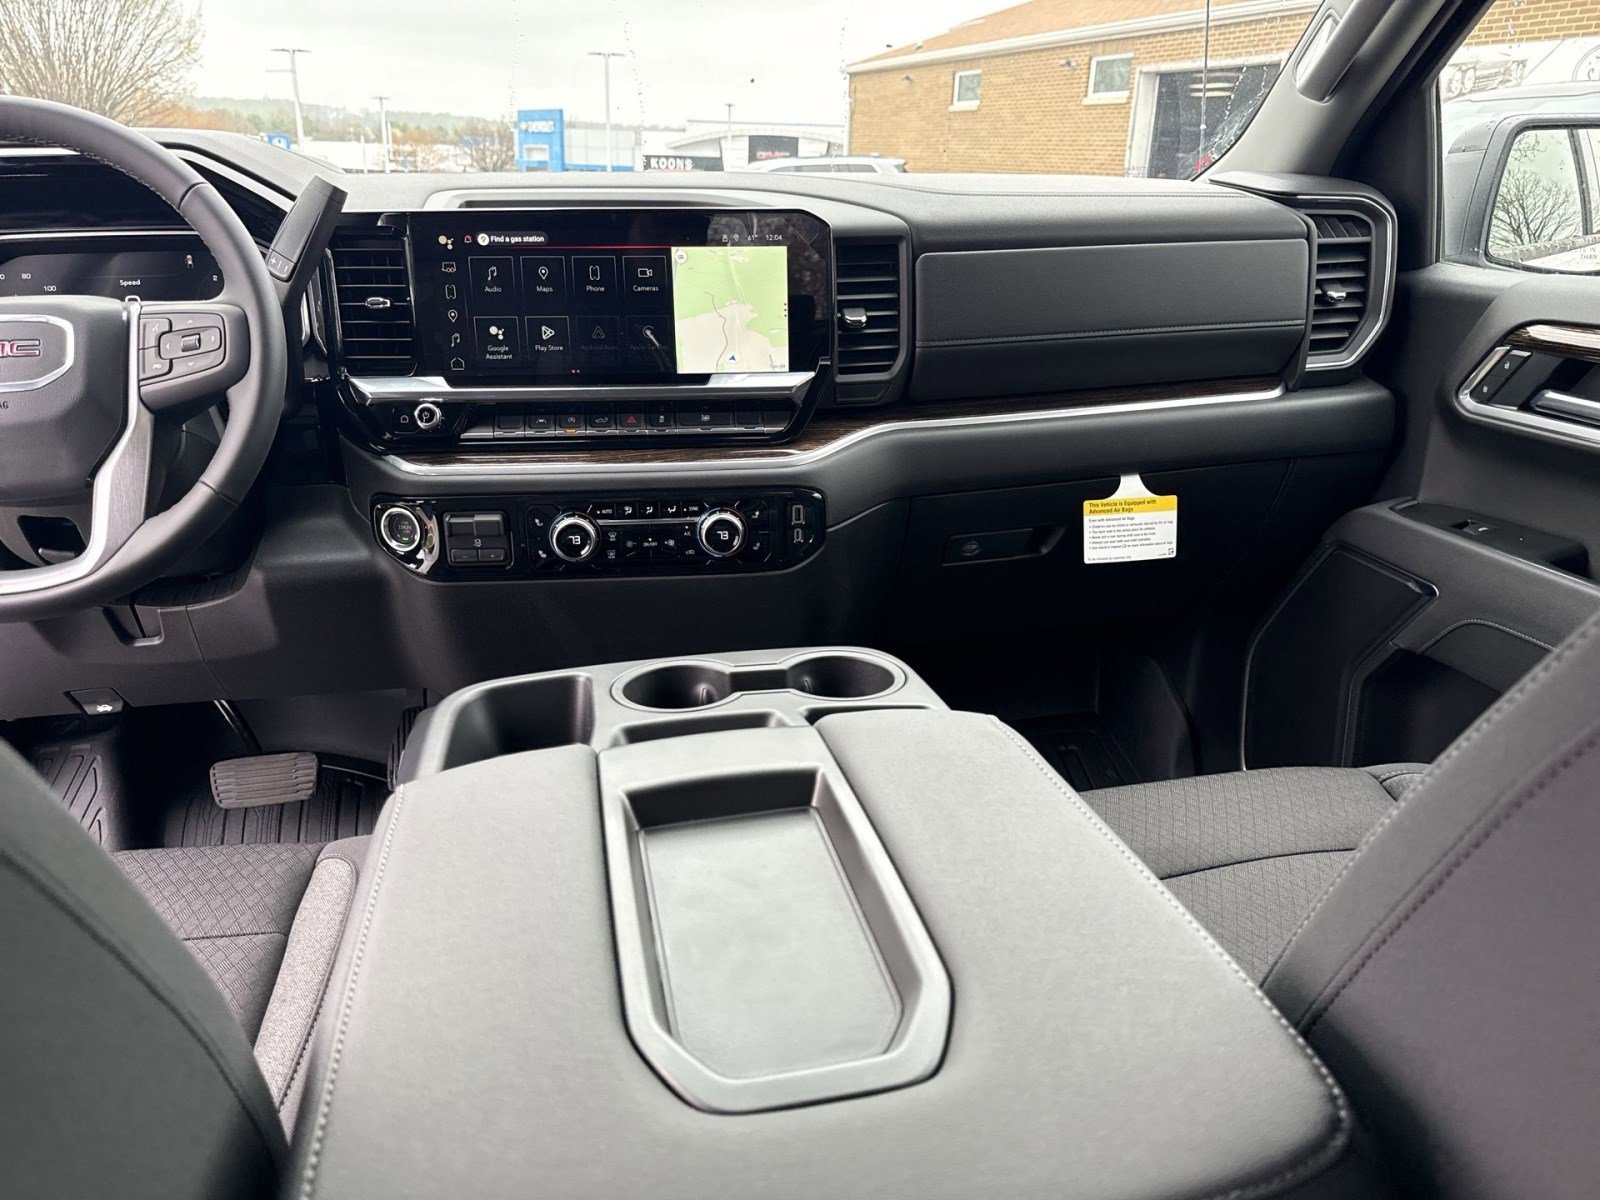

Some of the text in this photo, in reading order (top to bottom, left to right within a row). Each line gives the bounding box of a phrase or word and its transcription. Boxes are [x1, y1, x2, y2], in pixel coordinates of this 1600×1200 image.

[650, 157, 693, 170] KOONS
[490, 235, 504, 243] Find
[119, 278, 141, 287] Speed
[536, 286, 553, 294] Maps
[632, 284, 659, 292] Cameras
[487, 344, 509, 352] Google
[485, 352, 513, 360] Assistant
[717, 530, 729, 540] 73
[568, 535, 581, 545] 73
